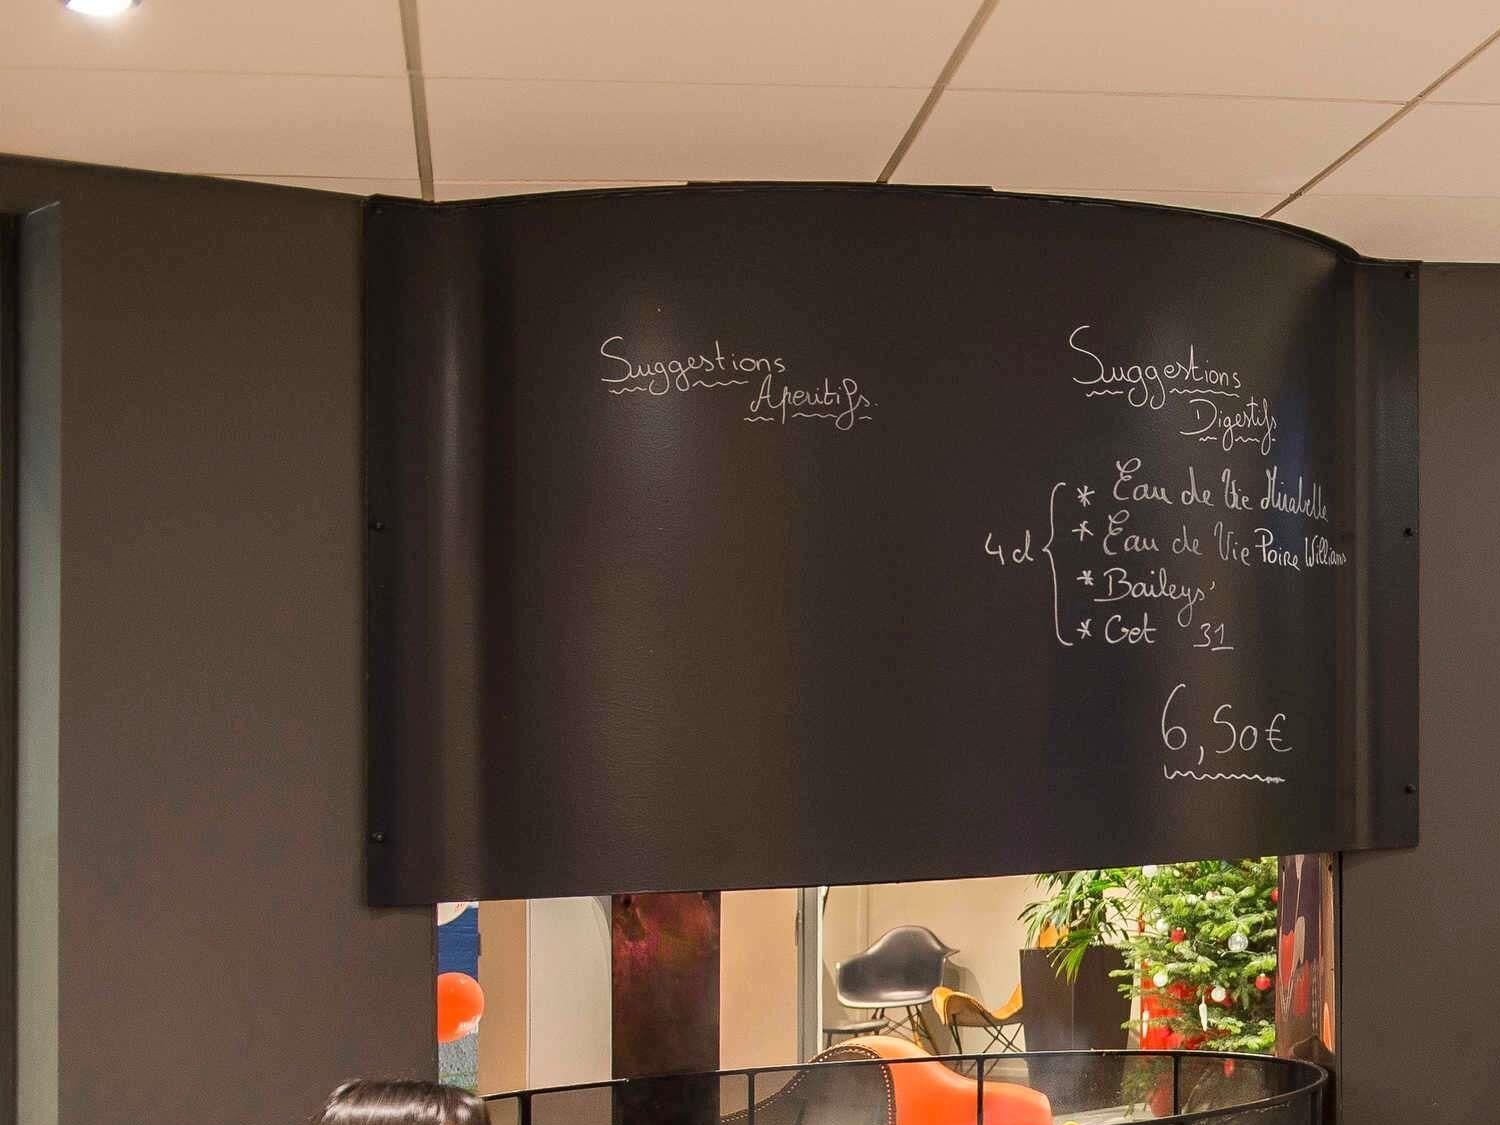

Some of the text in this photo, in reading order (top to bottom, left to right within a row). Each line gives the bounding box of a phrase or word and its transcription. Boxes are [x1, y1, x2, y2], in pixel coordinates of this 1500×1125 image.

[600, 336, 787, 396] Suggestions
[1068, 325, 1242, 410] Suggestions
[1179, 396, 1277, 456] Digestifs
[1112, 457, 1329, 523] Eau de Vie Mirabelle
[1103, 509, 1348, 571] Eau de Vie Poire Williams
[1104, 611, 1234, 651] Get 31
